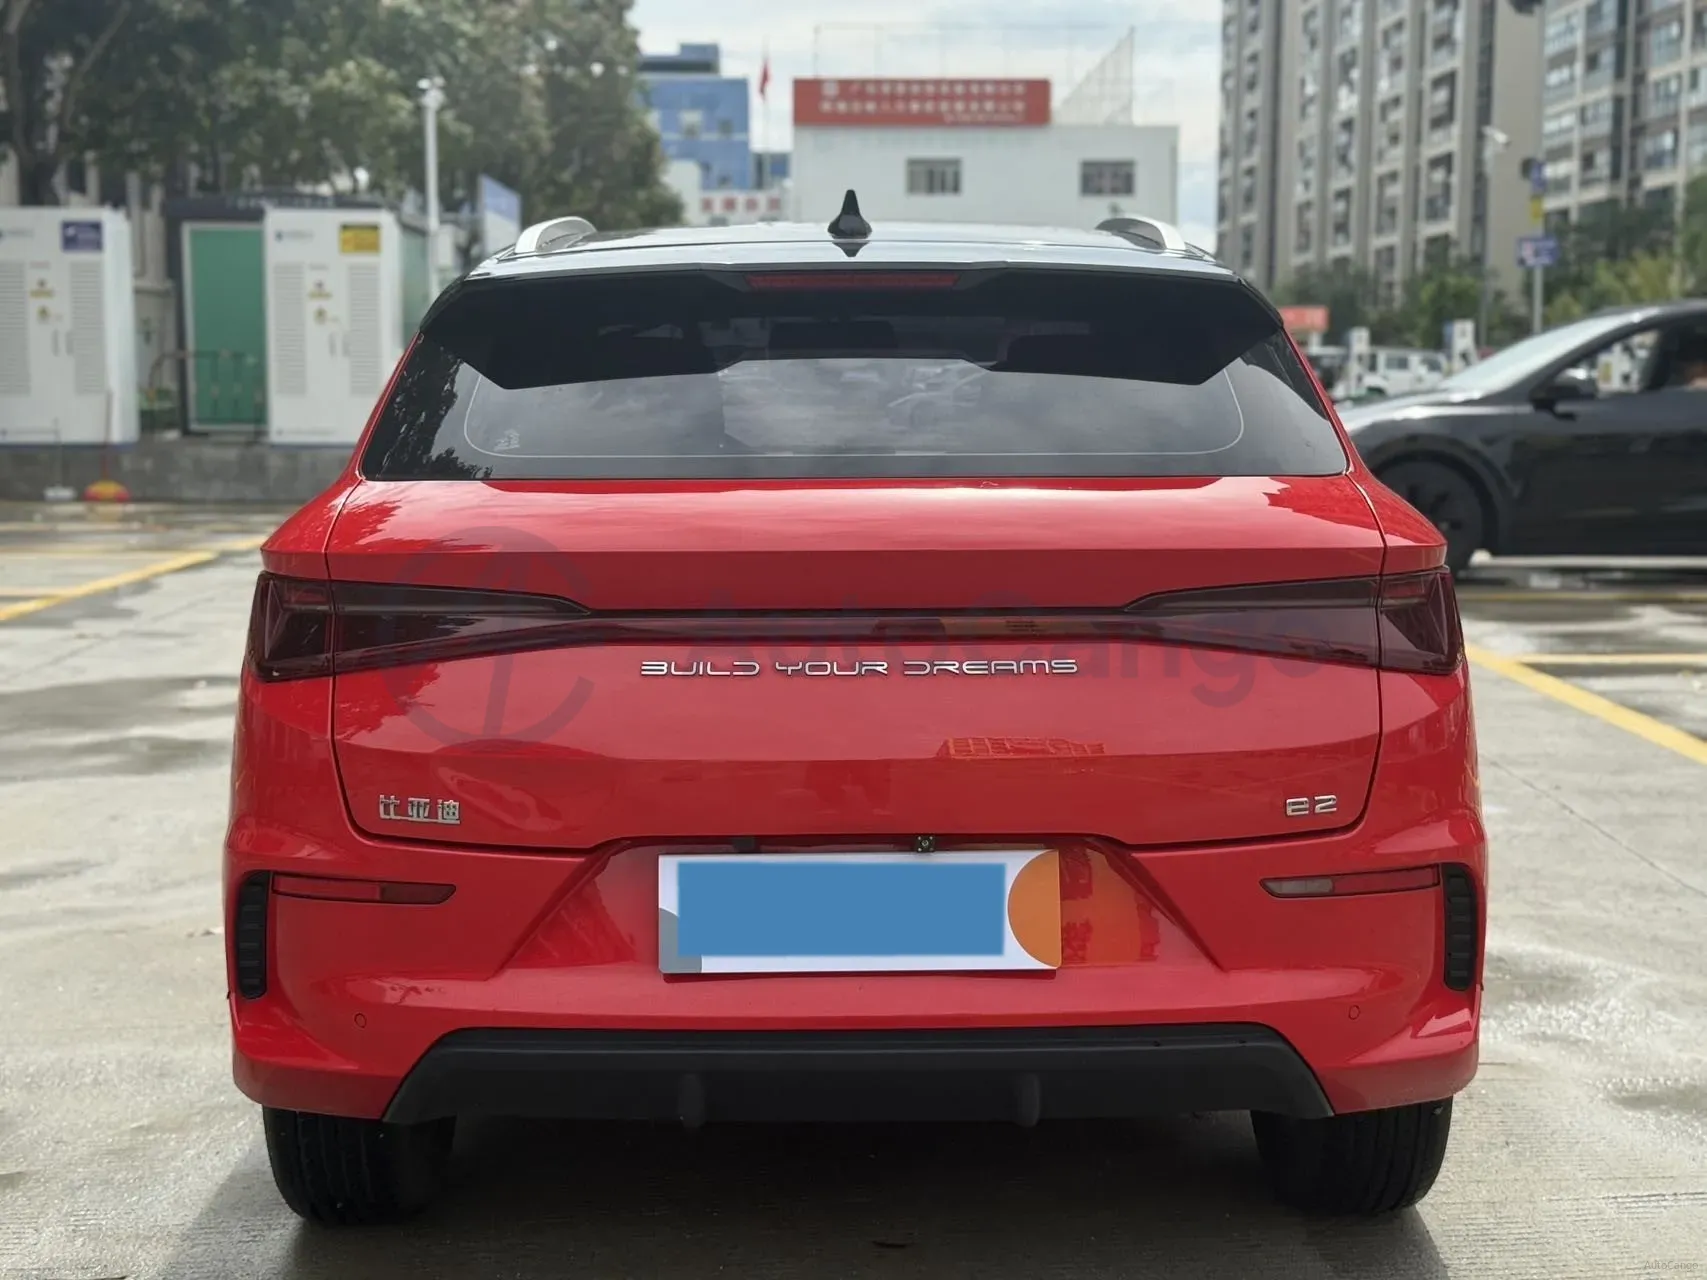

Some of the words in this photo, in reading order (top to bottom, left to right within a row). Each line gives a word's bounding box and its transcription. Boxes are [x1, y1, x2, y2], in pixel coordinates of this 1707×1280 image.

[641, 660, 760, 676] BUILD
[775, 660, 889, 676] YOUR
[903, 659, 1078, 676] DREAMS
[379, 794, 461, 825] 比亚迪
